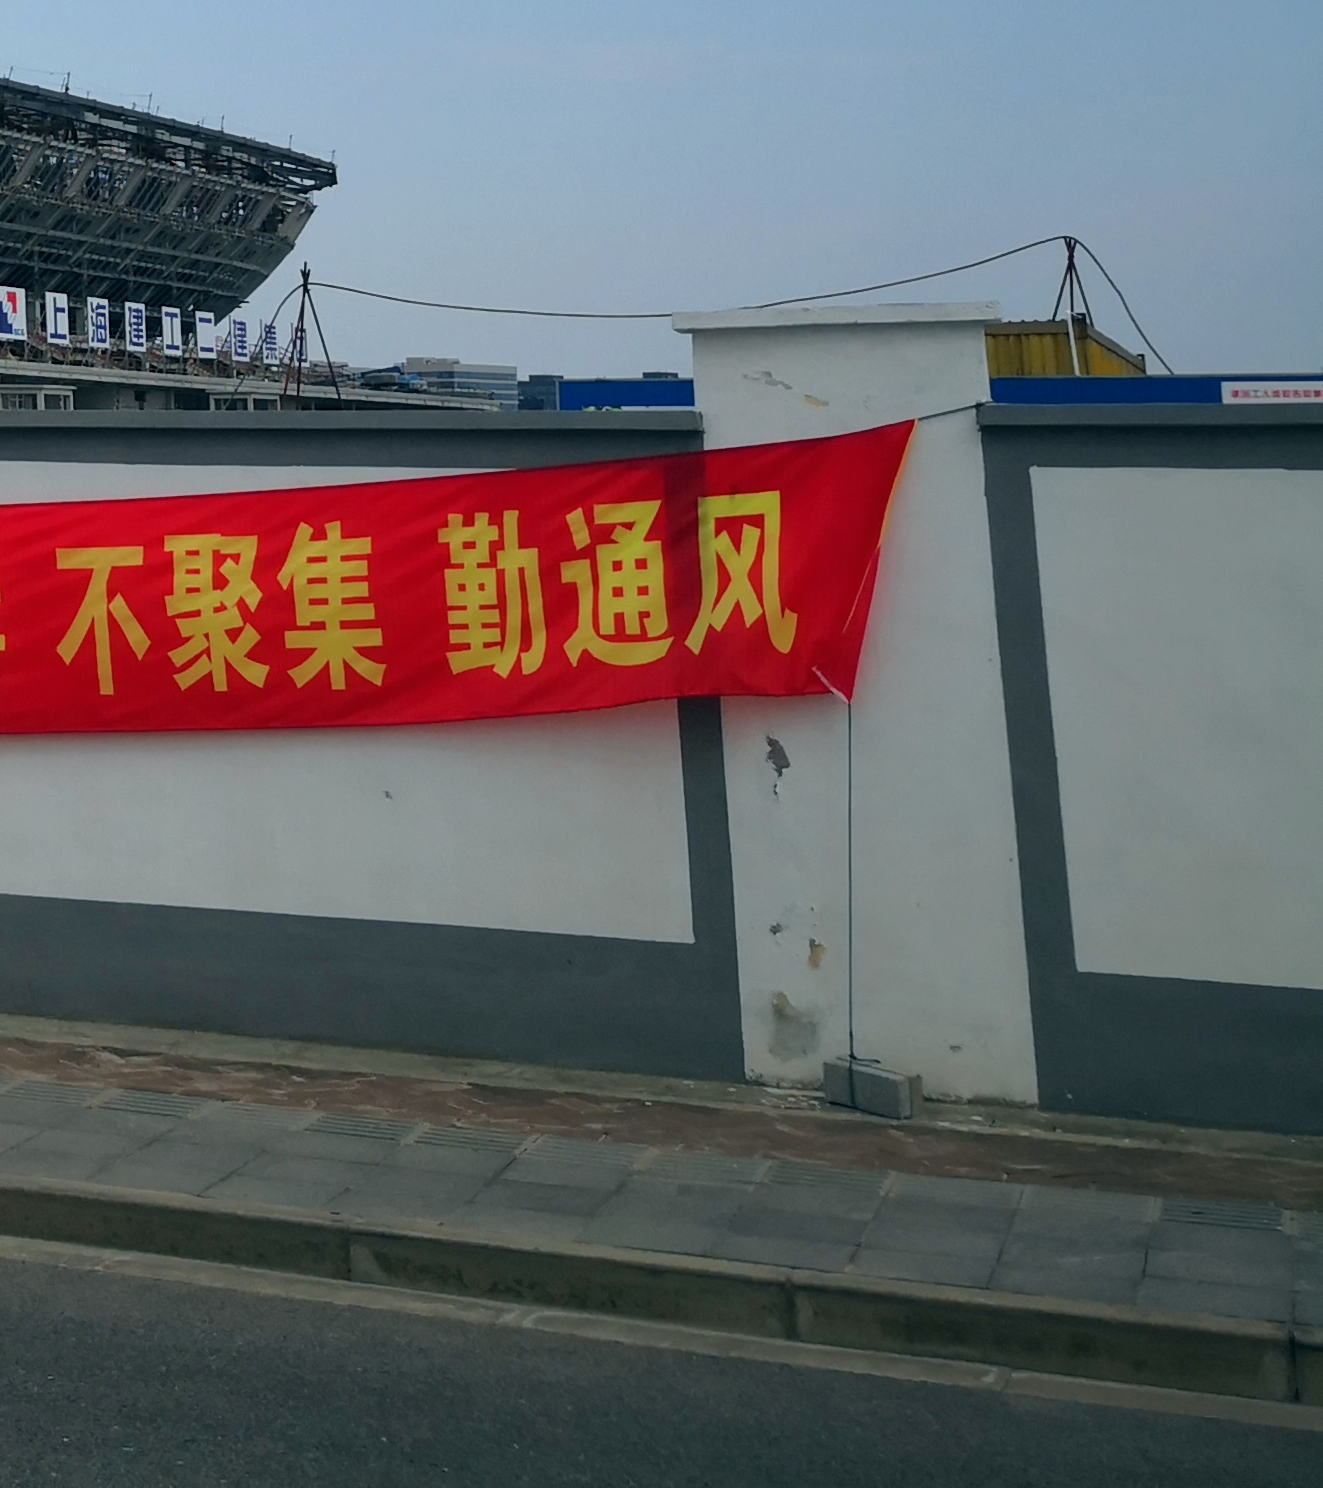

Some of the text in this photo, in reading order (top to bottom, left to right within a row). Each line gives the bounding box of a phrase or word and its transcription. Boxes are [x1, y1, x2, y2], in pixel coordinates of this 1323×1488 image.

[56, 521, 386, 695] 不聚集
[438, 490, 798, 678] 勤通风
